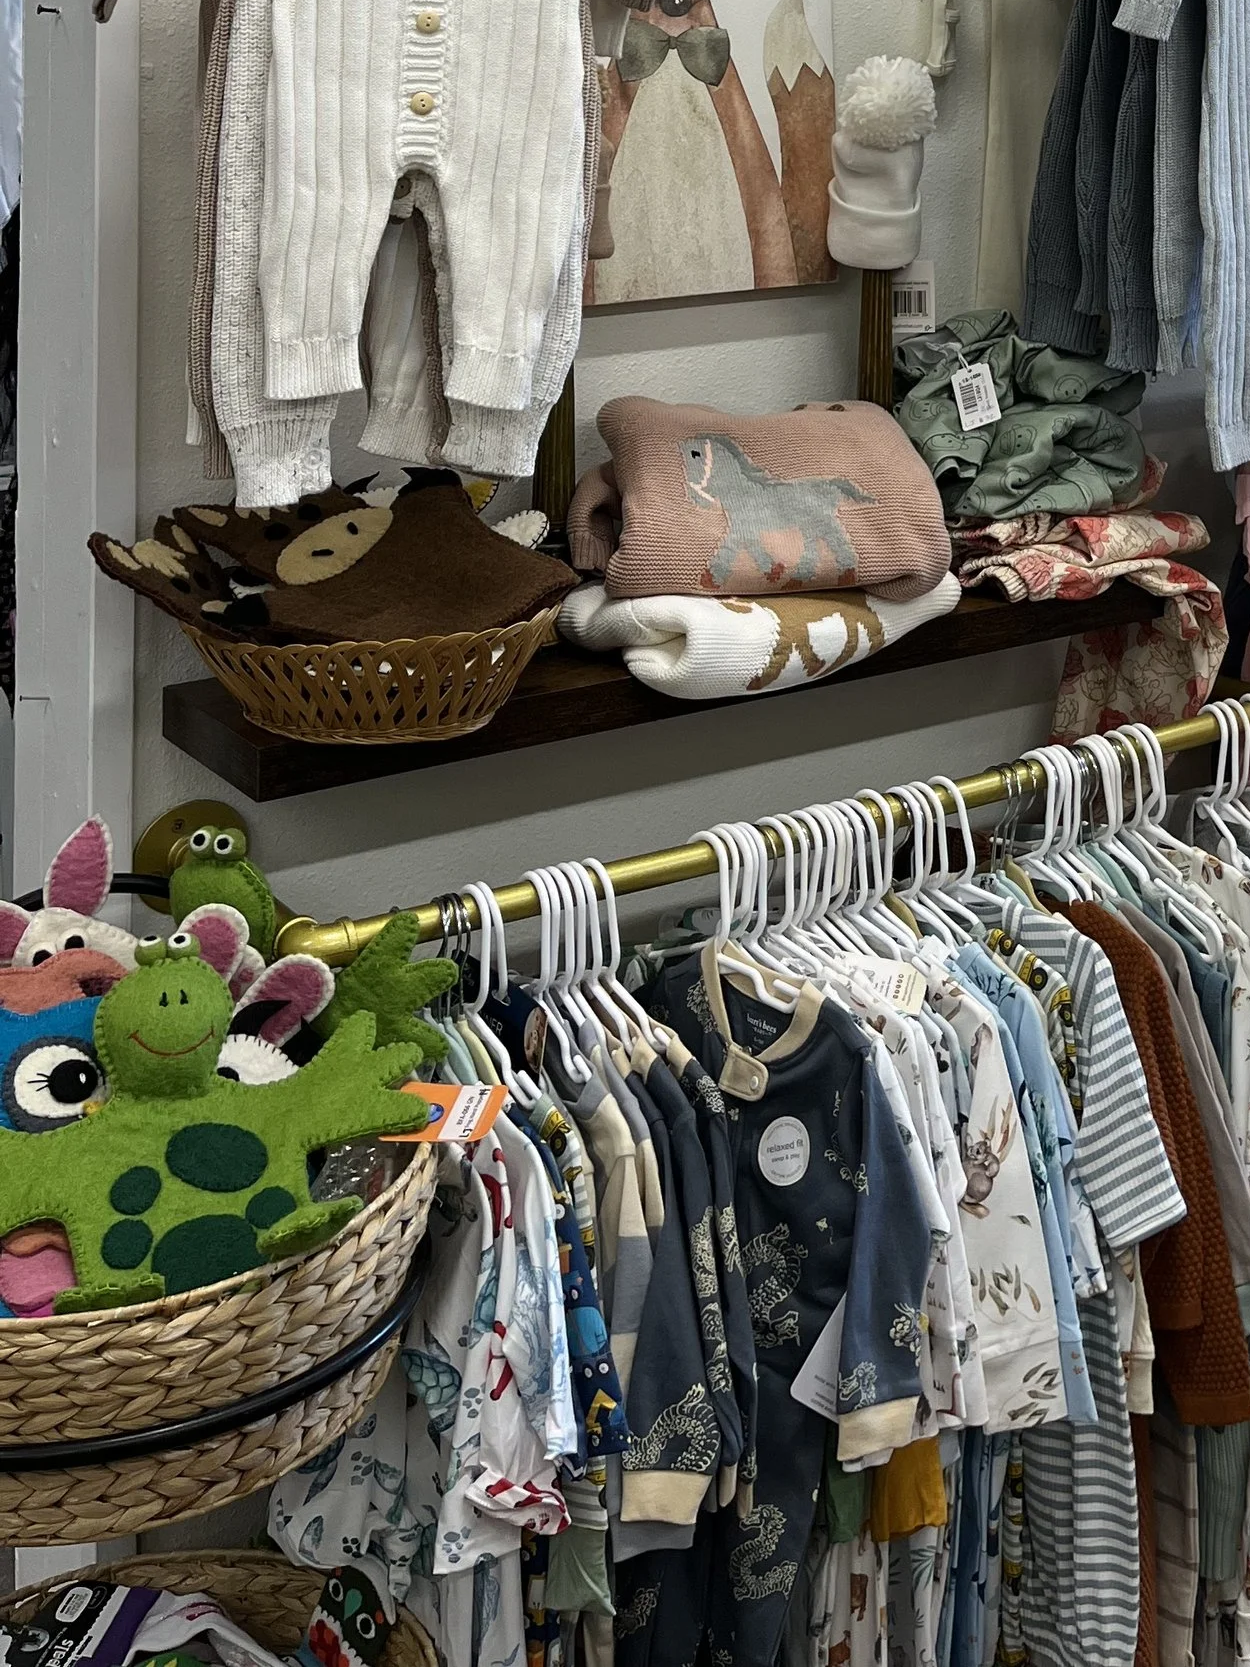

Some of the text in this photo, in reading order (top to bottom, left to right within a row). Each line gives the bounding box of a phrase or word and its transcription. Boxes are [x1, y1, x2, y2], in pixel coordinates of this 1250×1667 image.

[762, 1019, 777, 1035] bees
[766, 1138, 804, 1154] relaxed fit
